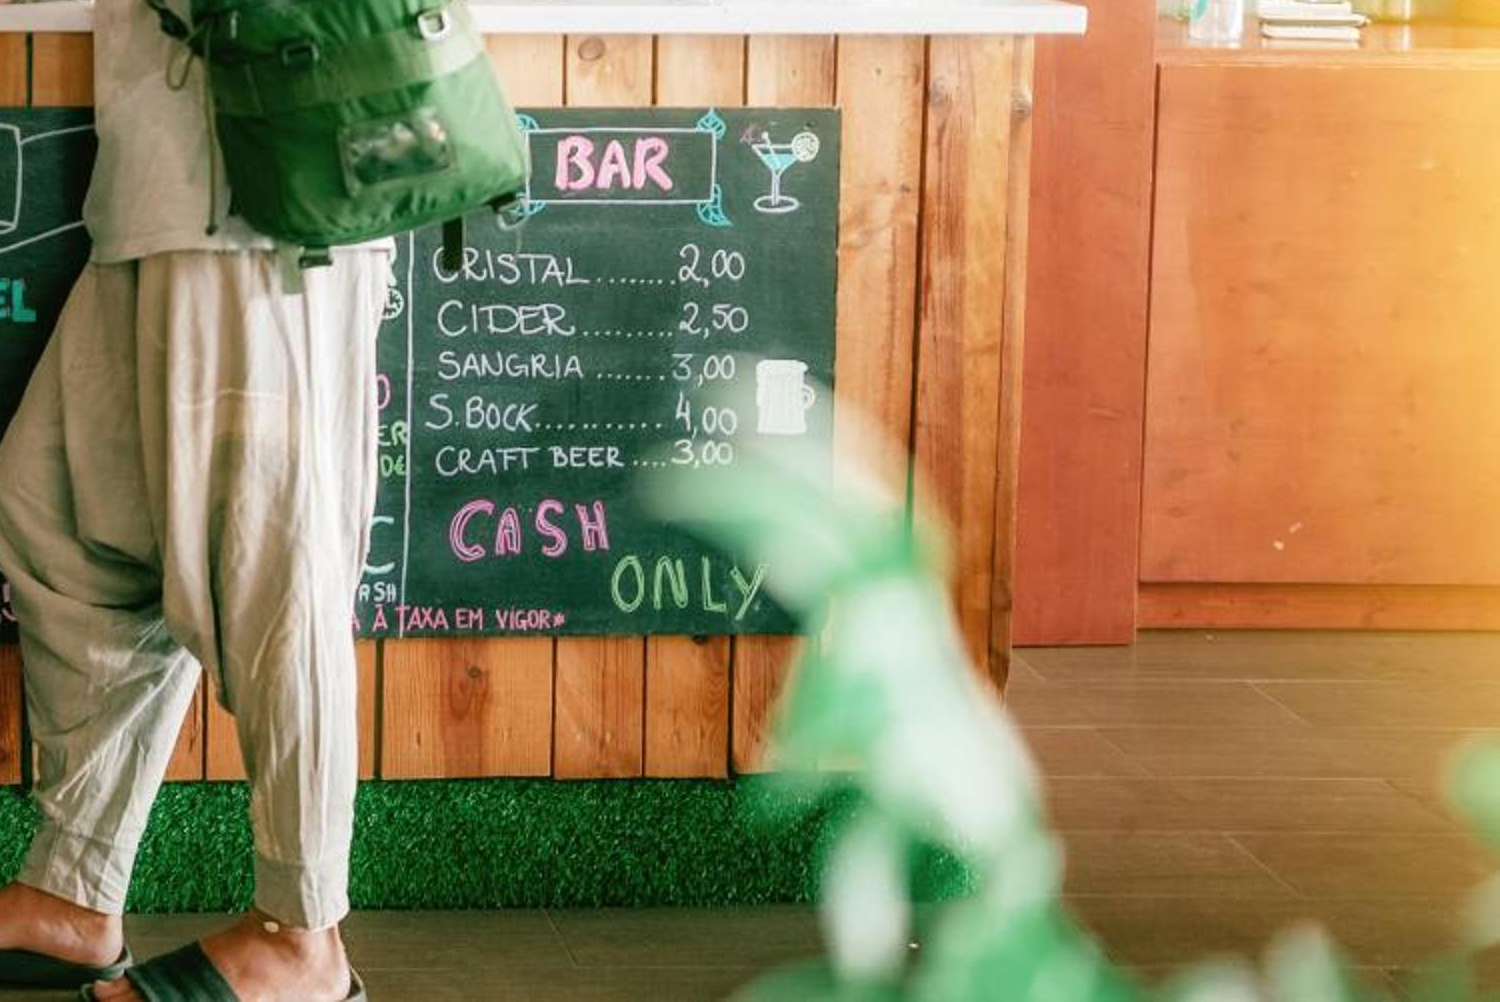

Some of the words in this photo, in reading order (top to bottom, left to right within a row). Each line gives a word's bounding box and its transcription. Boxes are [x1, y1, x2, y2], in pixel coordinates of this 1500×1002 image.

[554, 134, 674, 192] BAR
[433, 245, 590, 288] CRISTAL
[678, 243, 745, 288] 2,00
[437, 299, 576, 338] CIDER
[678, 301, 749, 339] 2,50
[437, 350, 585, 381] SANGRIA
[671, 353, 736, 387] 3,00
[675, 390, 738, 439] 4,00
[435, 445, 540, 476] CRAFT
[548, 444, 625, 470] BEER
[670, 438, 735, 470] 3,00
[448, 498, 611, 563] CASH
[610, 554, 770, 621] ONLY
[394, 605, 450, 632] TAXA
[455, 607, 485, 631] EM
